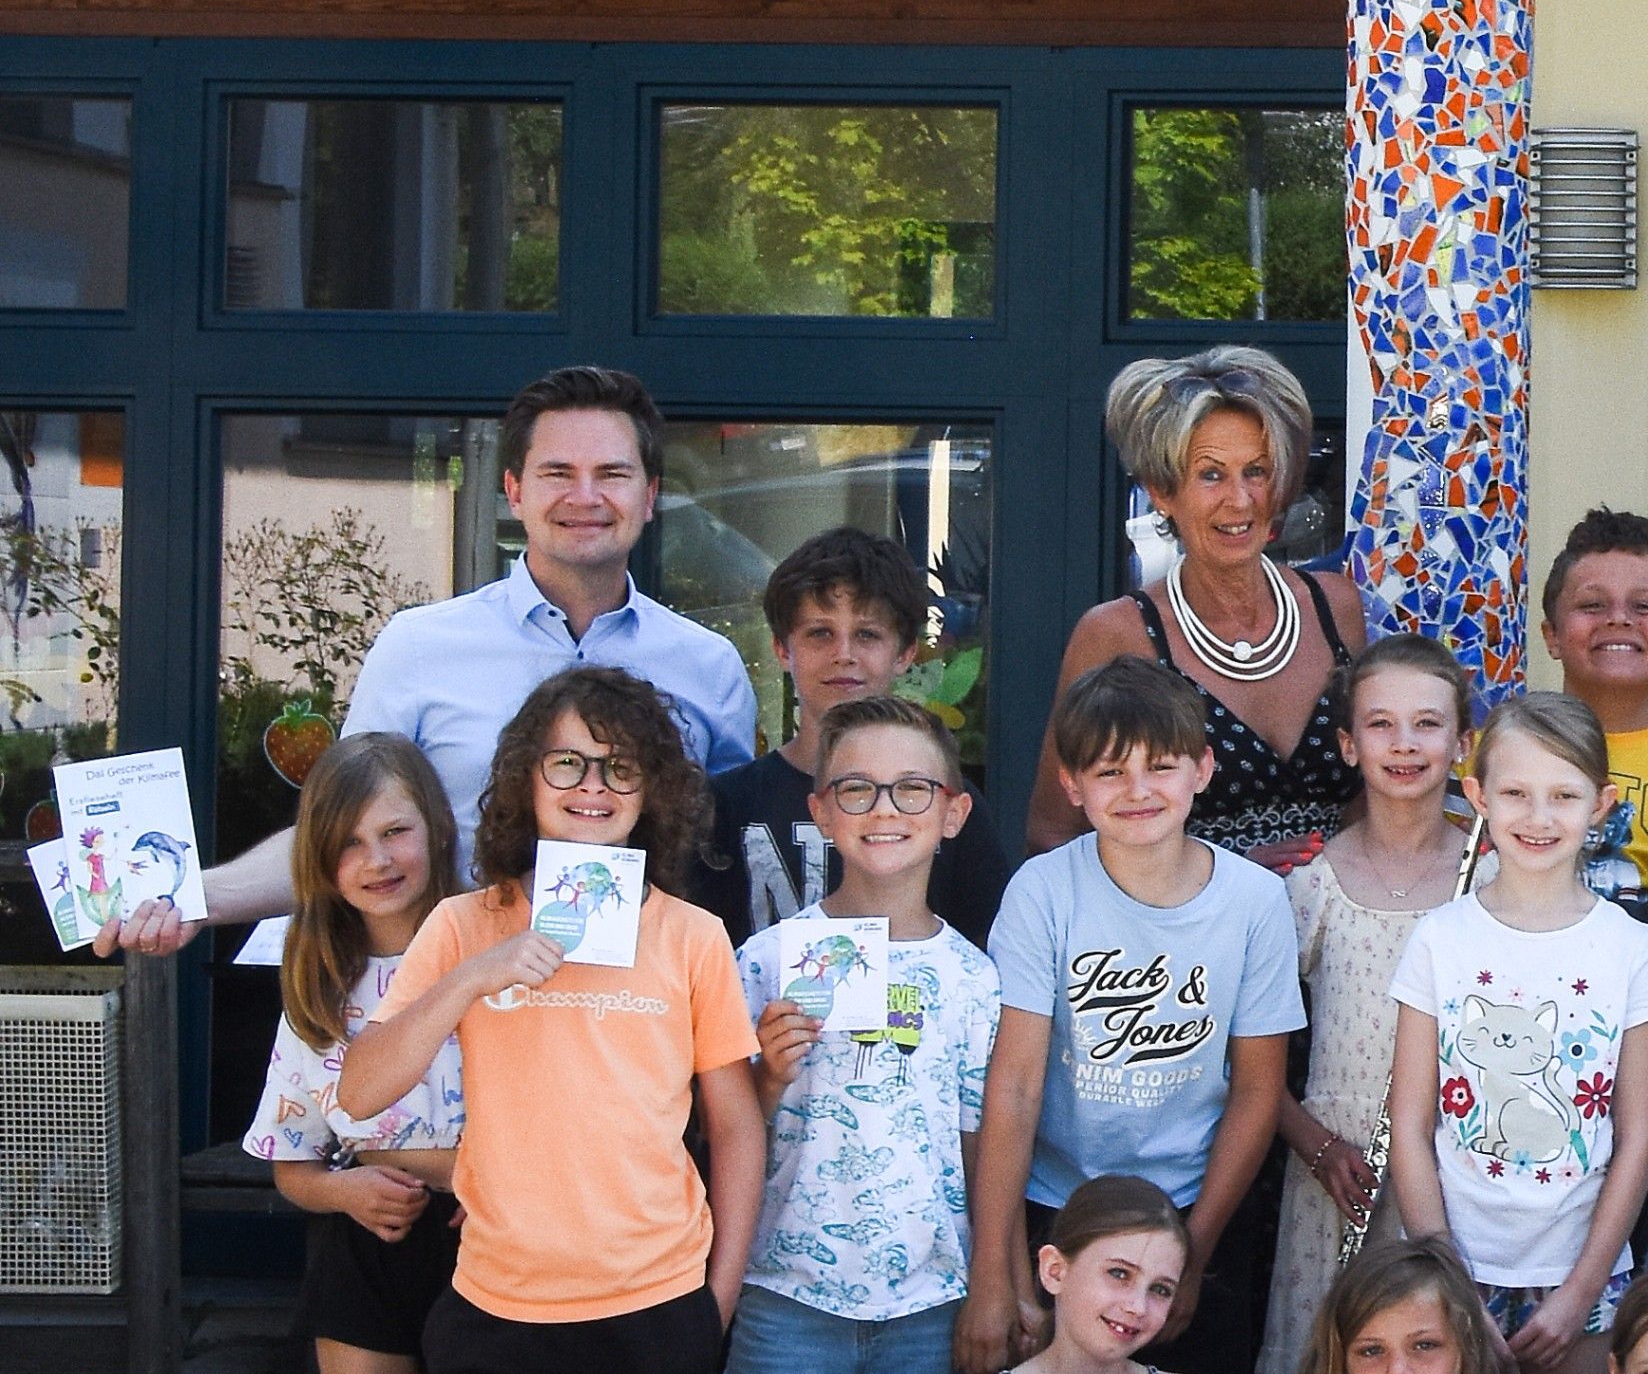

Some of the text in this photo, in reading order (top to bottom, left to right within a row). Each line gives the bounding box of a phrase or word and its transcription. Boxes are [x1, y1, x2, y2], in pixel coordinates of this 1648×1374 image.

[483, 983, 669, 1019] Champion
[1068, 948, 1207, 1013] Jack &
[1090, 1004, 1213, 1065] Jones
